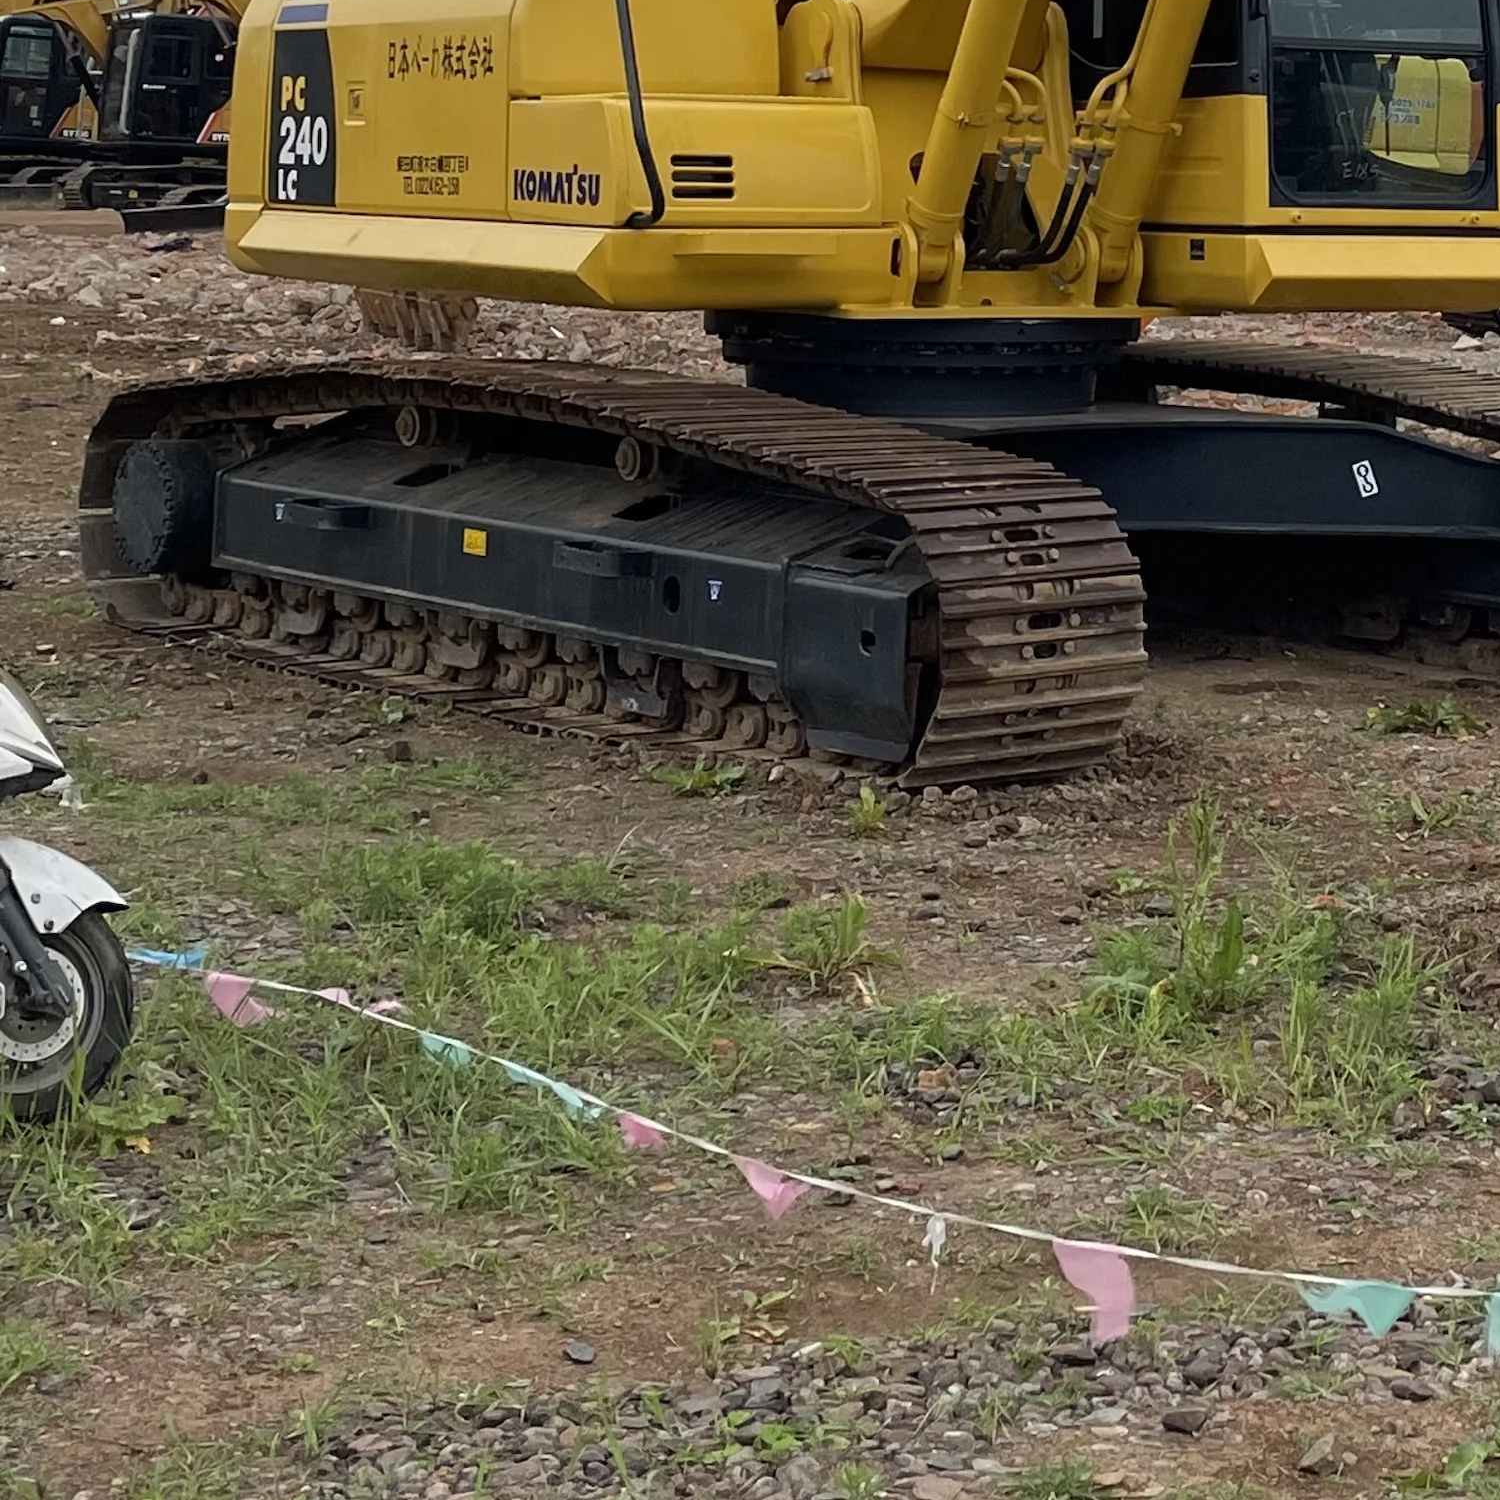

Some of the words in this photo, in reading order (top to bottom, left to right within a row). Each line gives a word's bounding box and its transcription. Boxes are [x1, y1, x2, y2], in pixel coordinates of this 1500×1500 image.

[280, 75, 307, 112] PC
[278, 115, 328, 166] 240
[277, 169, 299, 201] LC
[514, 164, 601, 206] KOMATSU
